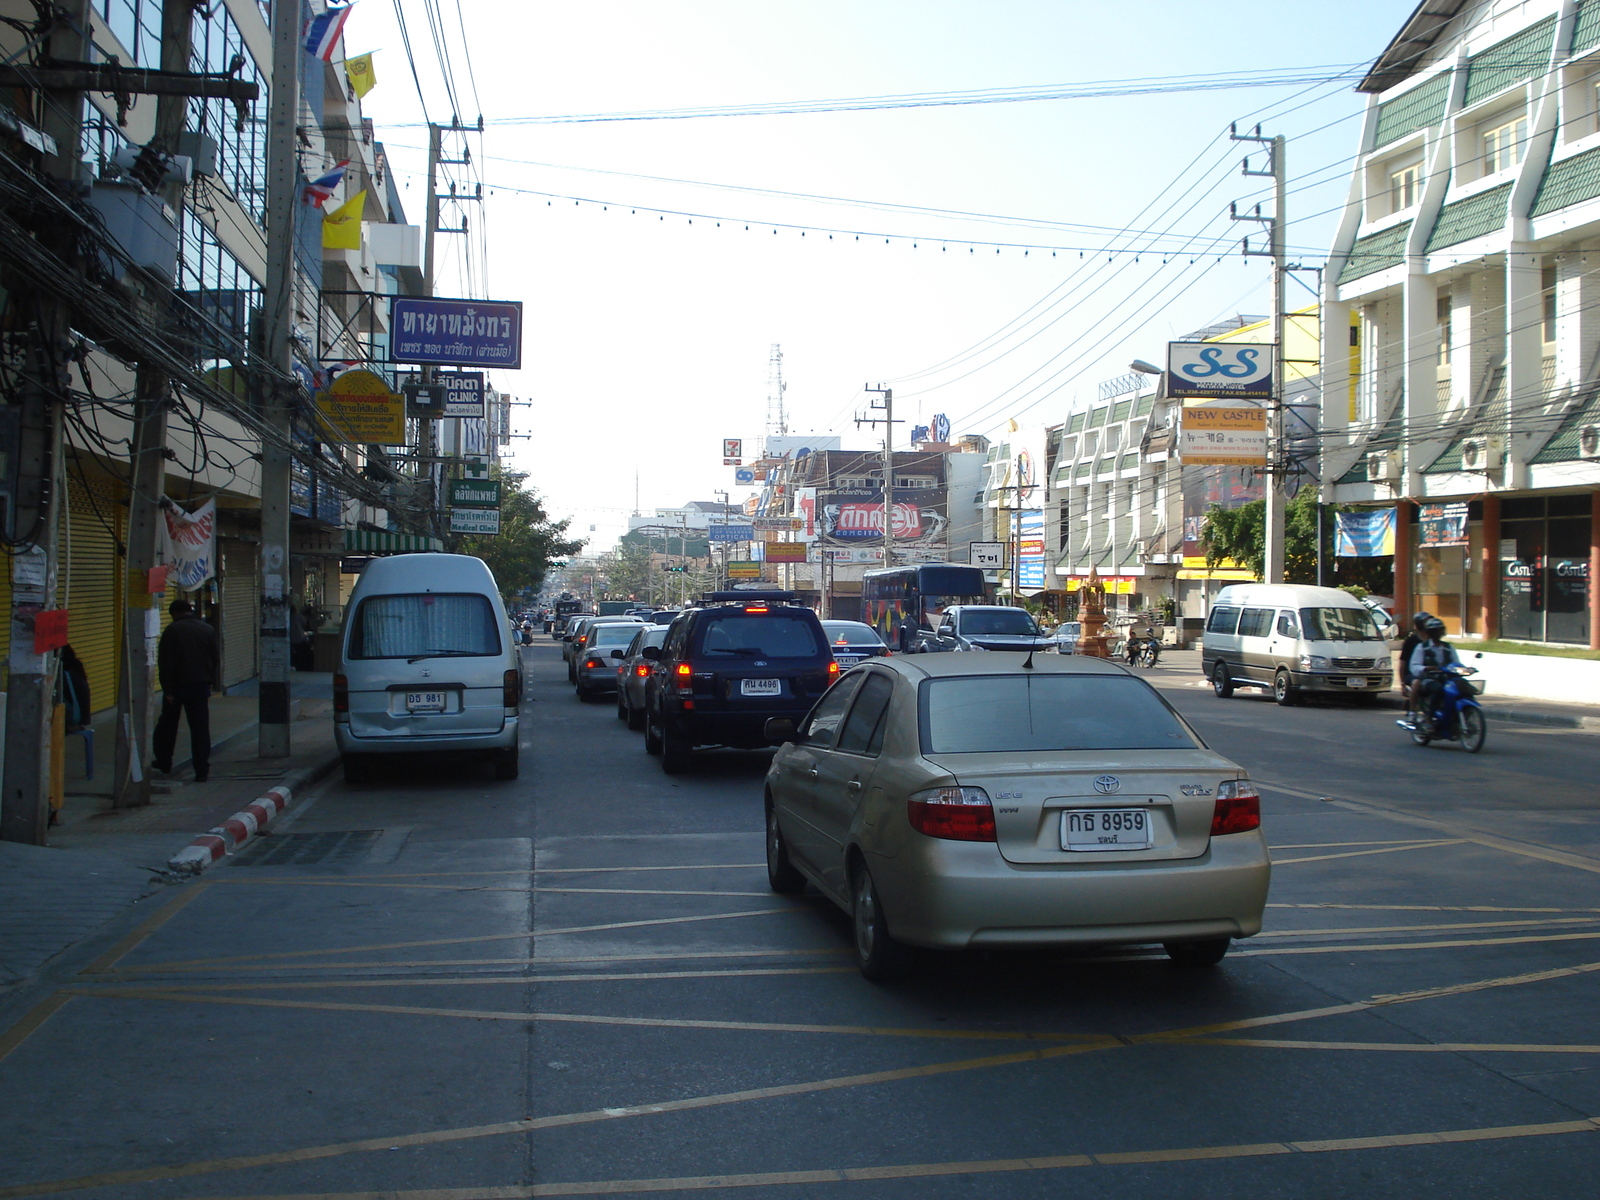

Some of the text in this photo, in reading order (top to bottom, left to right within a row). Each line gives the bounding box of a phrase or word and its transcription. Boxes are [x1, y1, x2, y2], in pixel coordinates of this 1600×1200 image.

[424, 343, 442, 354] ทอง
[1226, 382, 1246, 390] HOTEL
[448, 391, 478, 402] CLINIC
[1188, 410, 1264, 421] NEW CASTLE
[452, 524, 478, 532] Medical
[426, 694, 441, 702] 981
[1069, 813, 1144, 832] กธ 8959
[1098, 834, 1118, 843] ชลบรี
